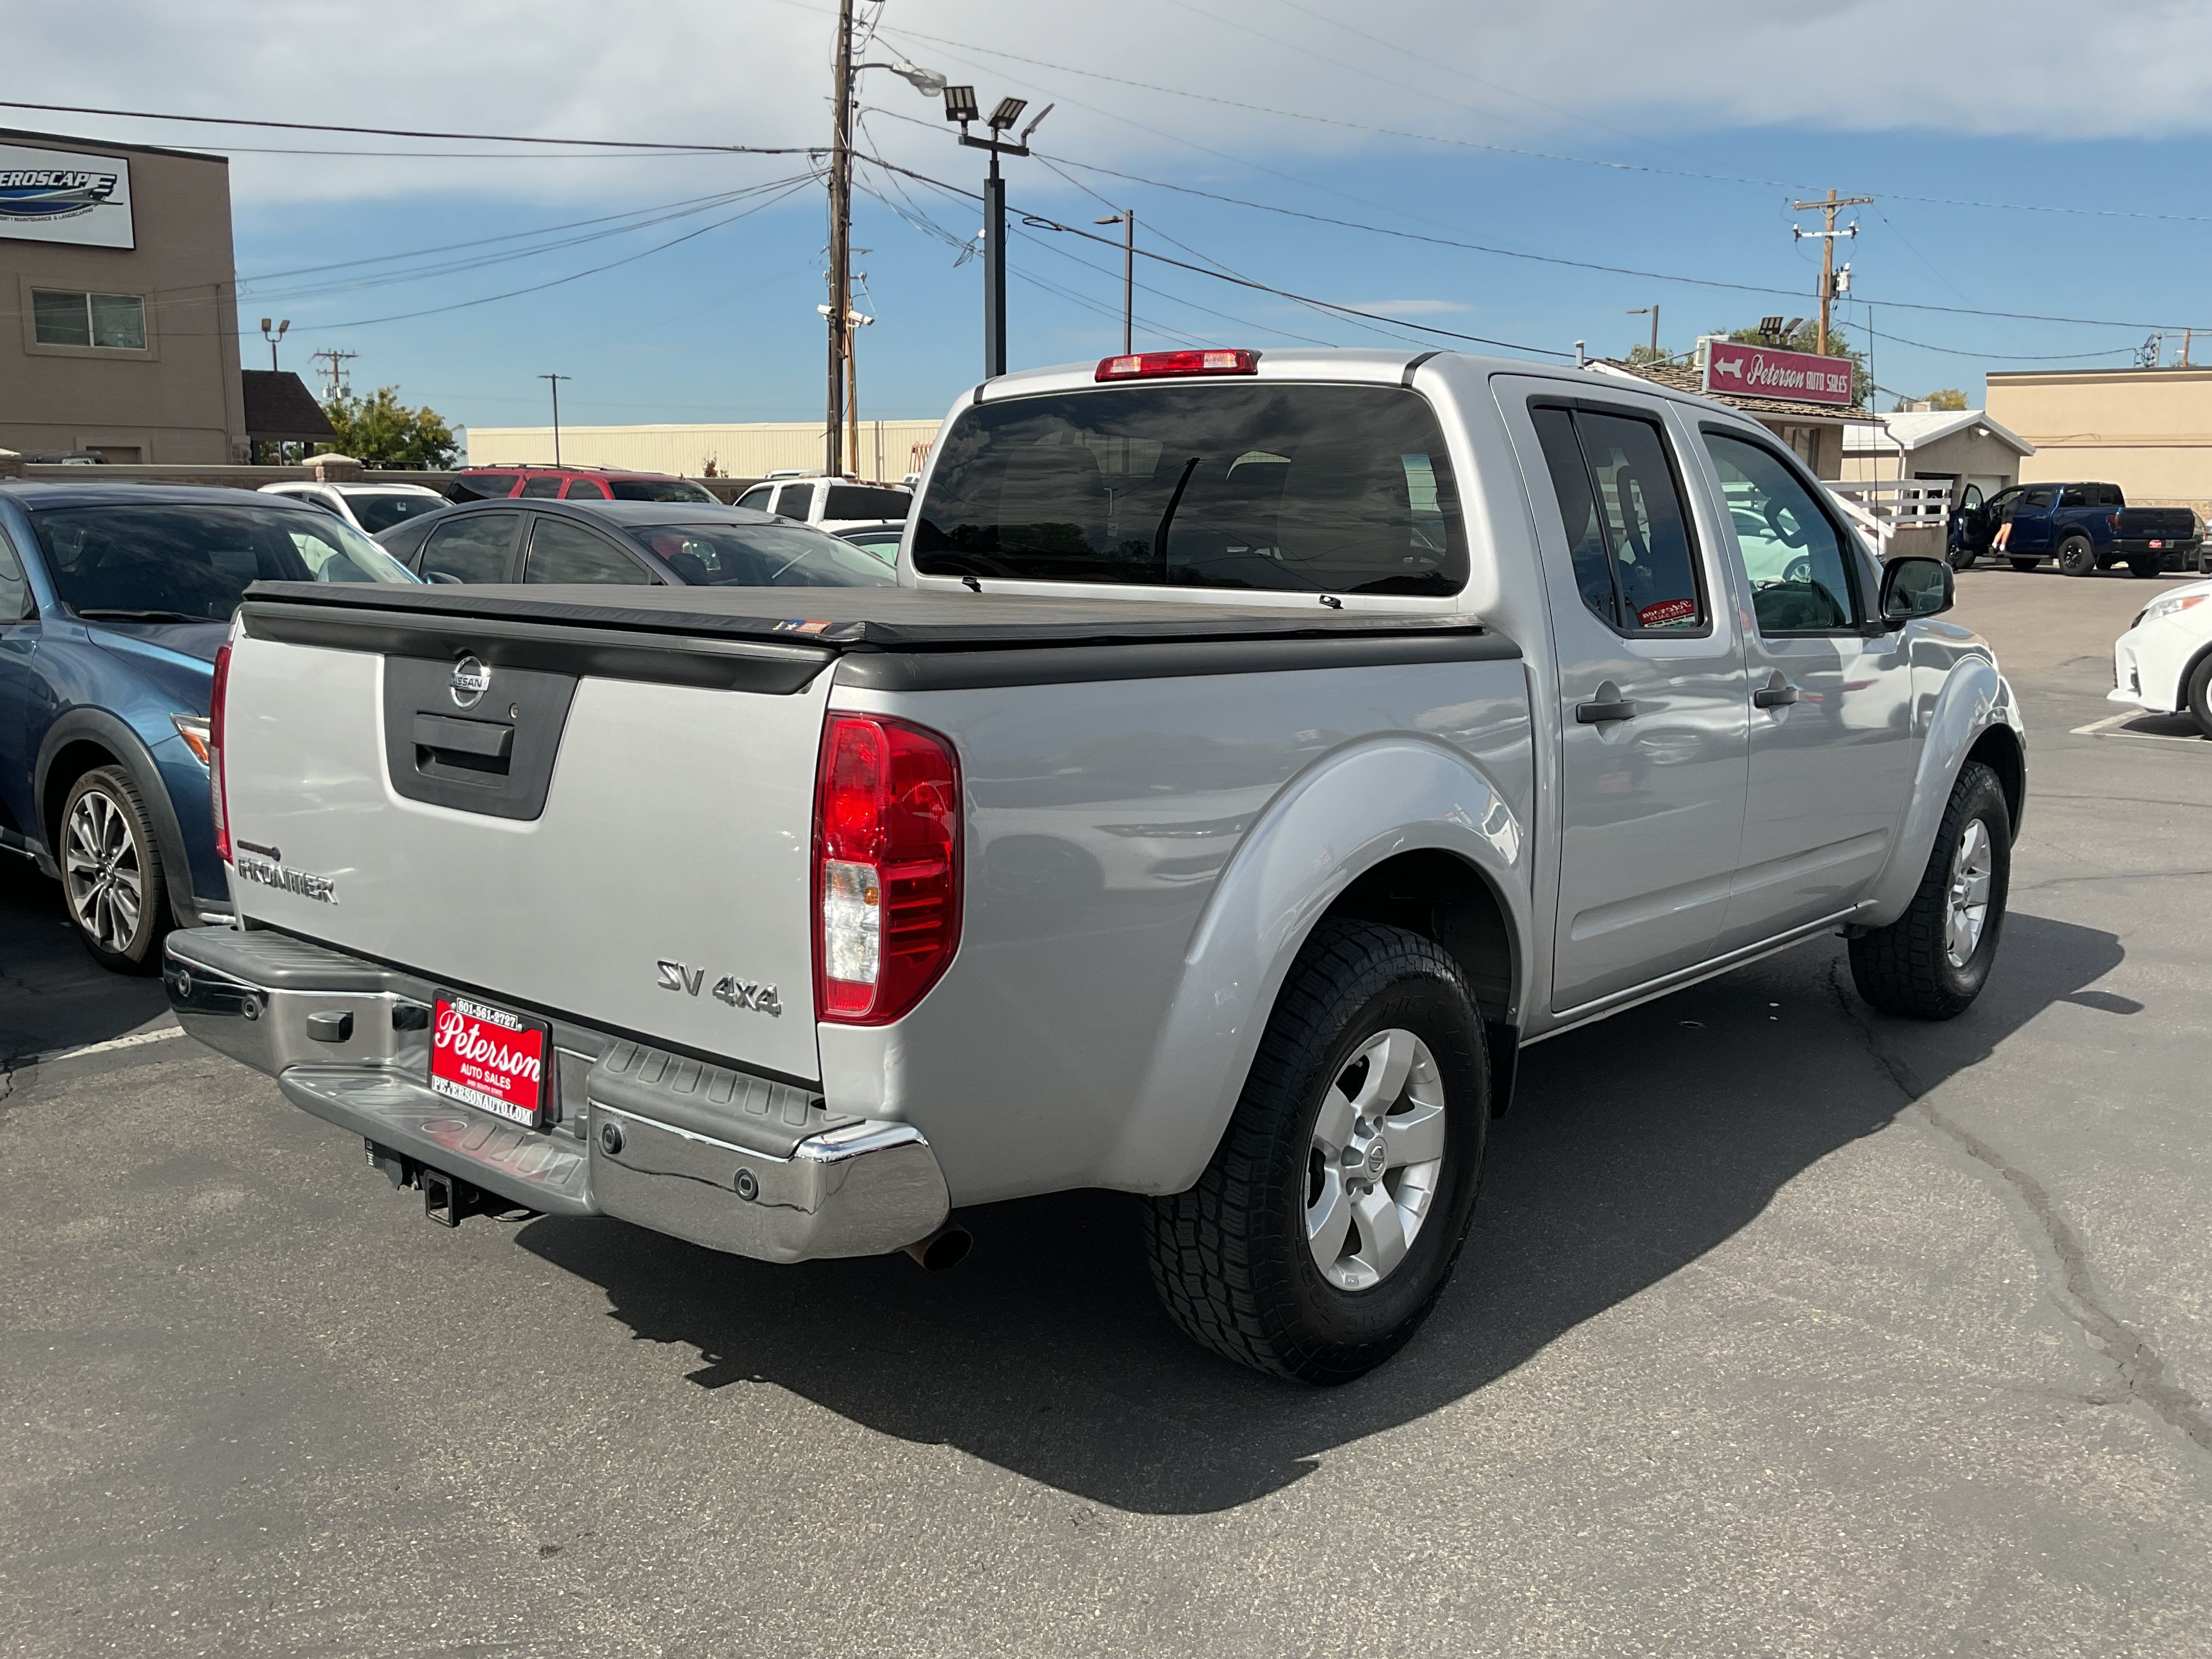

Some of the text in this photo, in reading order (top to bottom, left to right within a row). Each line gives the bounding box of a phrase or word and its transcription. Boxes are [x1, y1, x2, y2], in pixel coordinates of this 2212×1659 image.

[59, 207, 93, 219] LANDSCAPING
[1747, 354, 1848, 394] Peterson AUTO SALES
[450, 675, 482, 687] NISSAN
[238, 855, 338, 905] FRONTIER
[657, 957, 705, 997] SV
[458, 1000, 517, 1029] 801-561-2727
[435, 1010, 540, 1082] Peterson
[460, 1063, 483, 1080] AUTO
[484, 1073, 511, 1090] SALES
[433, 1076, 532, 1125] PETERSONAUTO.COM
